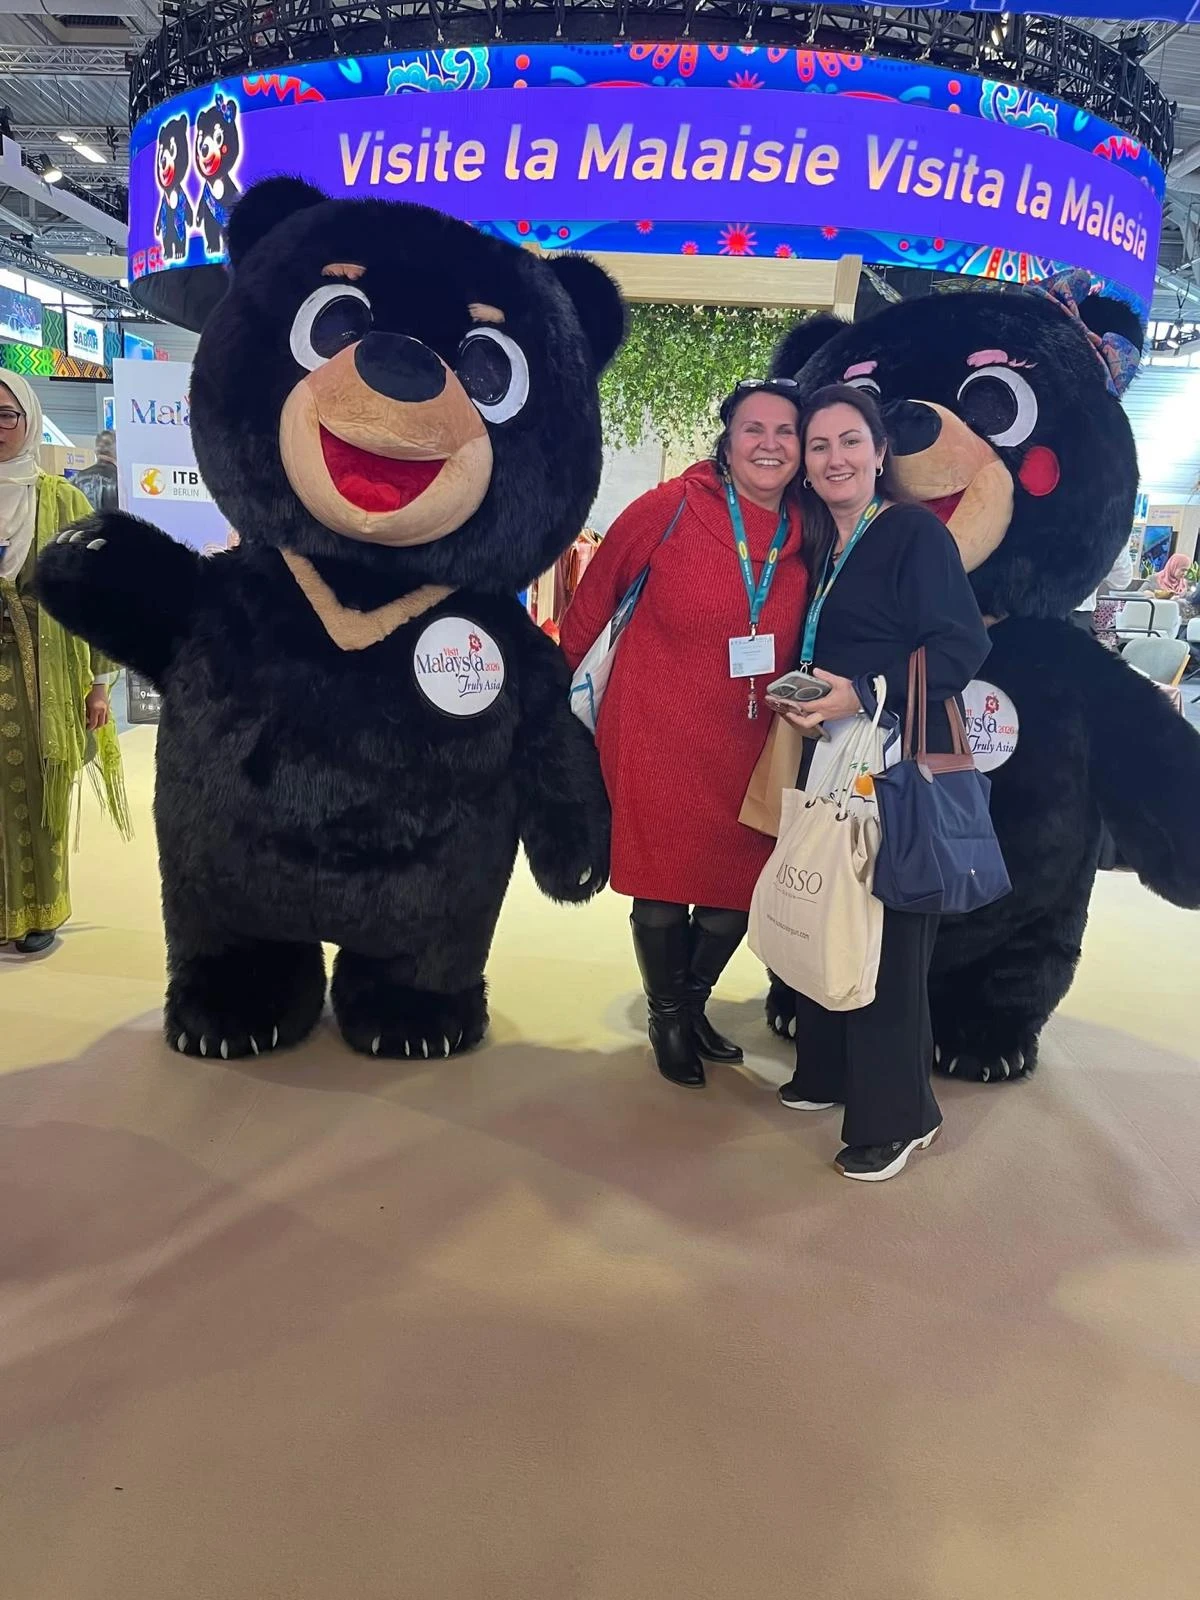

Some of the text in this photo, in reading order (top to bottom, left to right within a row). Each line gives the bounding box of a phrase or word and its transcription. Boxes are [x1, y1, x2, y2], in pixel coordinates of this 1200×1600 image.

[339, 124, 840, 186] Visite la Malaisie
[867, 135, 1148, 262] Visita la Malesia
[73, 330, 98, 350] SABAH
[173, 471, 199, 485] ITB
[173, 488, 200, 497] BERLIN
[416, 651, 485, 678] Malaysia
[458, 675, 500, 697] Truly Asia
[968, 735, 1014, 755] Truly Asia
